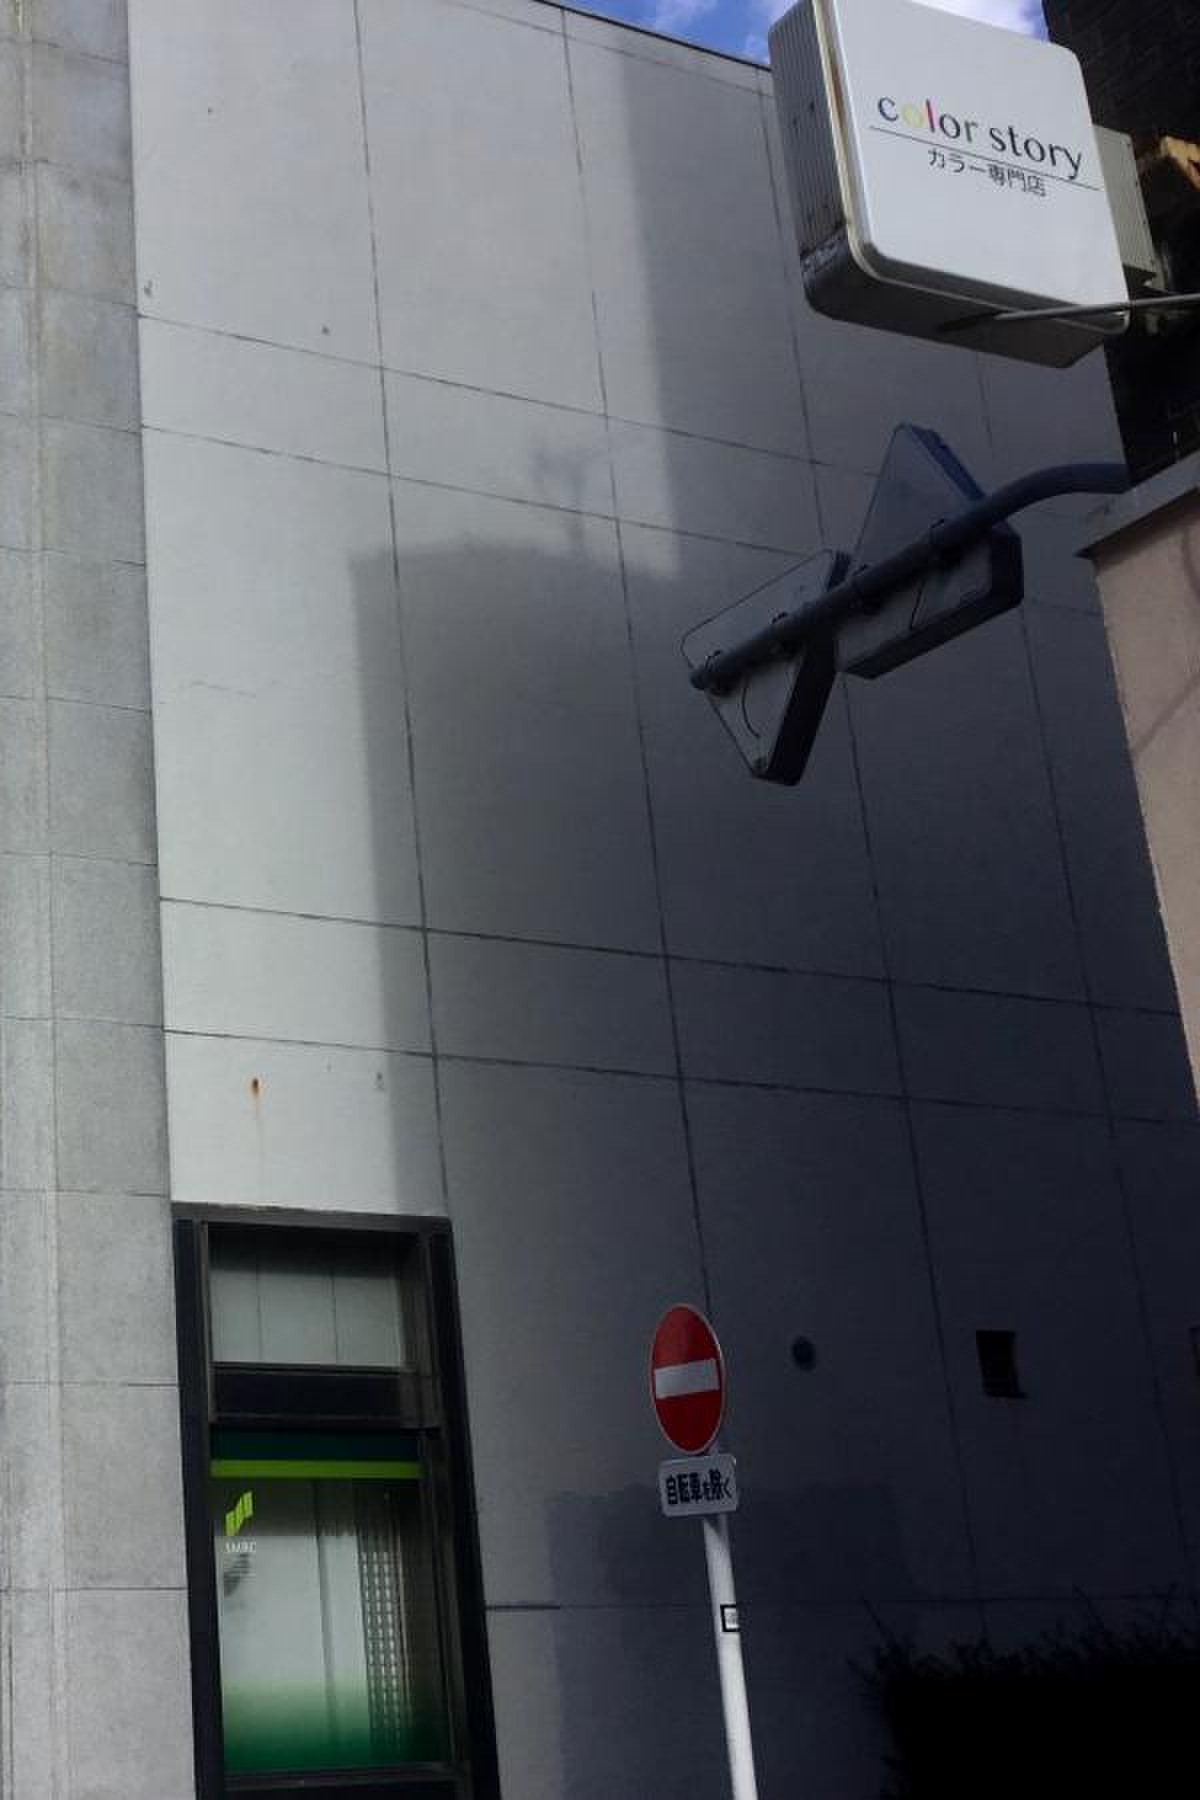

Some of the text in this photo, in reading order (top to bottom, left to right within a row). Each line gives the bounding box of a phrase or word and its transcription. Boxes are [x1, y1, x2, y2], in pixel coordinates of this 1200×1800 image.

[877, 97, 1082, 180] color story
[927, 148, 1047, 197] カラー専門店
[666, 1469, 732, 1506] 自転車を除く
